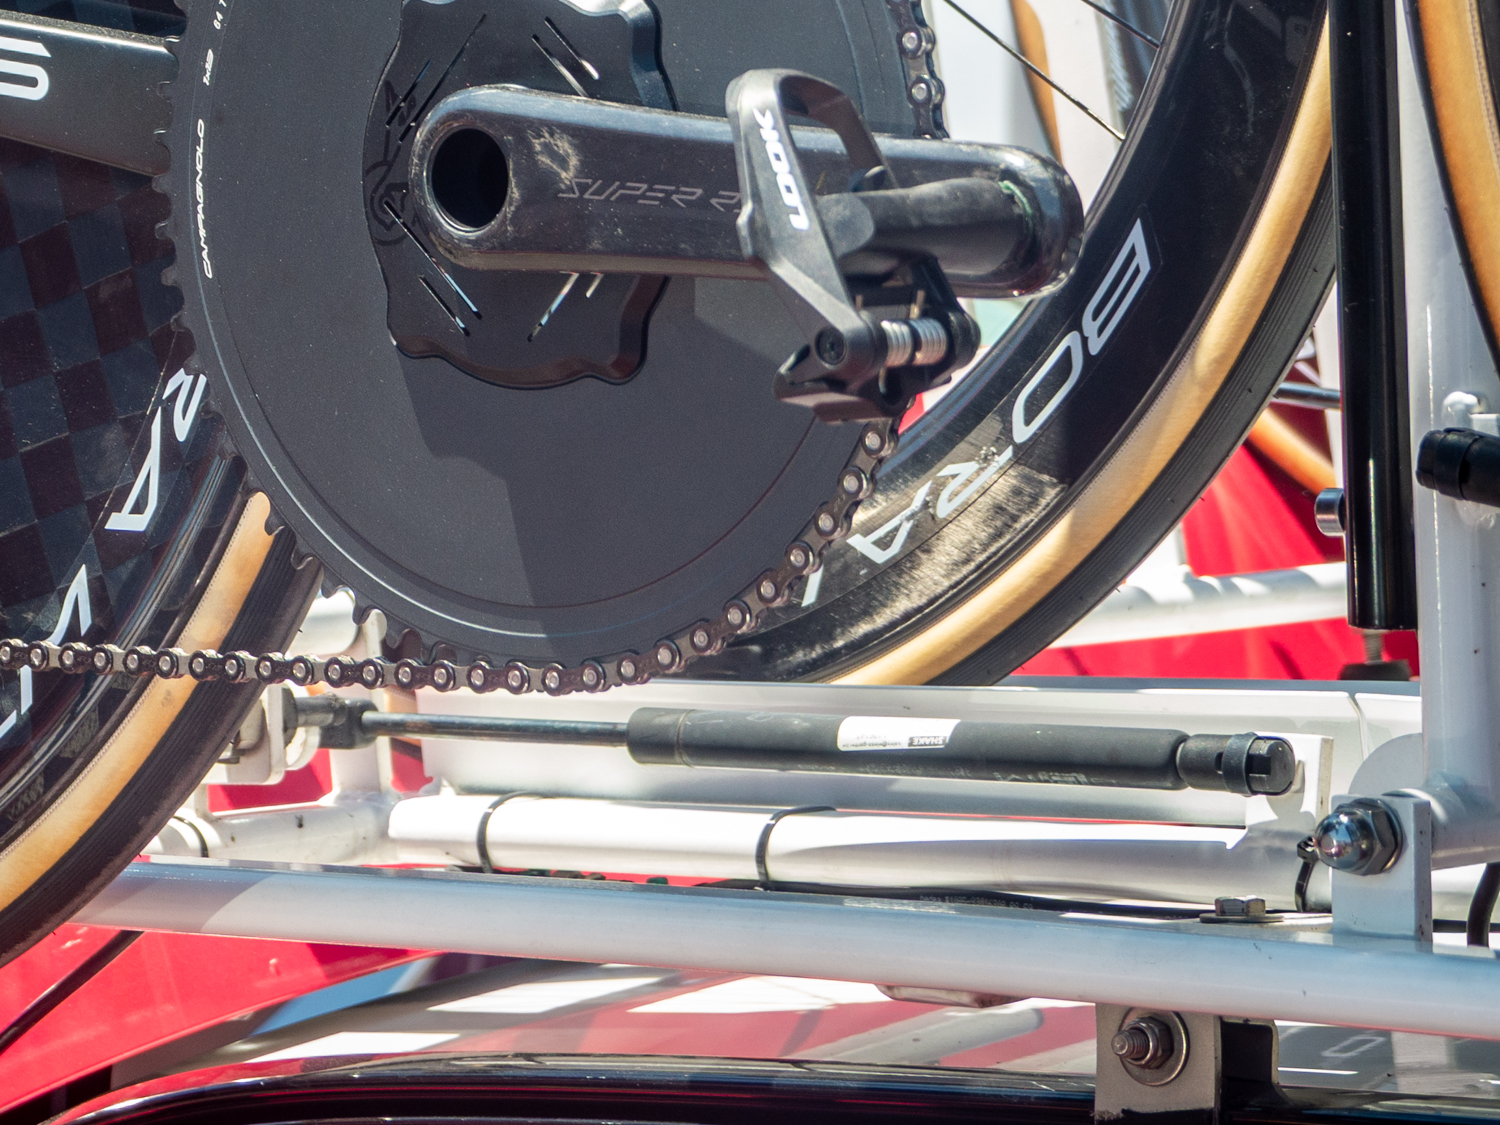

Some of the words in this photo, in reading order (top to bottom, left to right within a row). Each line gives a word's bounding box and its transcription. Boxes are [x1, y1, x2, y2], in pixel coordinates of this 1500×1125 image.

[196, 118, 213, 279] CAMPAGNOLO
[213, 10, 224, 30] 64
[557, 177, 703, 208] SUPER
[752, 107, 810, 231] LOOK
[846, 217, 1152, 565] BORA
[911, 736, 945, 747] SHAKE
